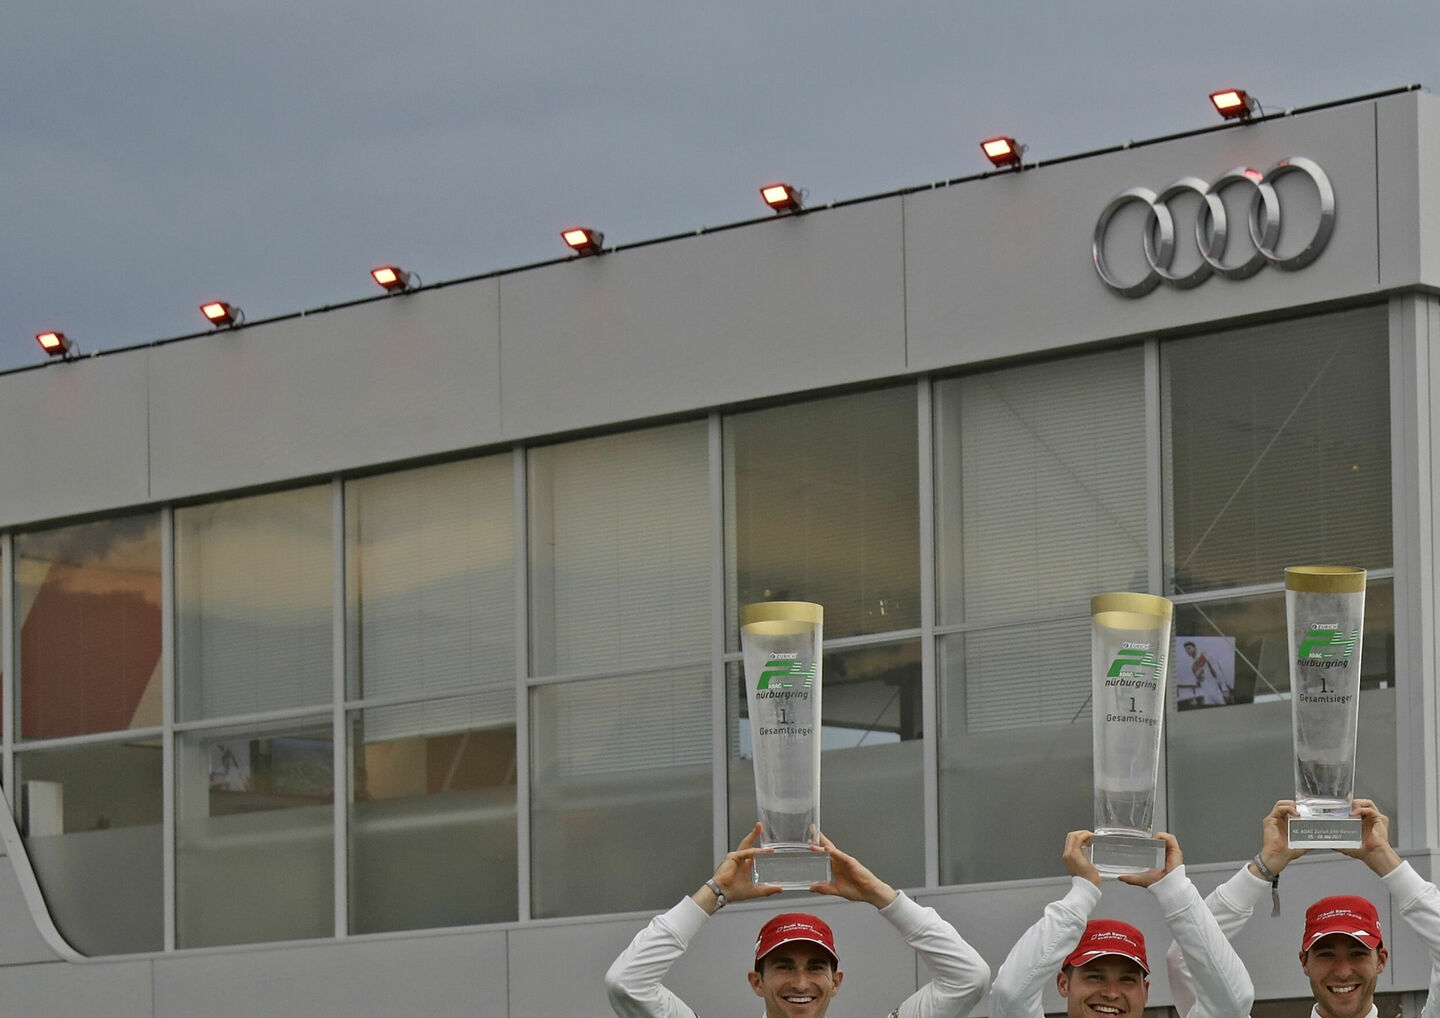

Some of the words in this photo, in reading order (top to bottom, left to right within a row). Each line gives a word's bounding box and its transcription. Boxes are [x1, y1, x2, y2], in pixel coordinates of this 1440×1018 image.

[1297, 659, 1349, 669] nürburgring
[1105, 679, 1157, 691] nürburgring
[1321, 678, 1334, 693] 1.
[756, 690, 808, 700] nürburgring
[1299, 694, 1352, 704] Gesamtsieger
[1129, 697, 1143, 713] 1.
[780, 709, 795, 724] 1.
